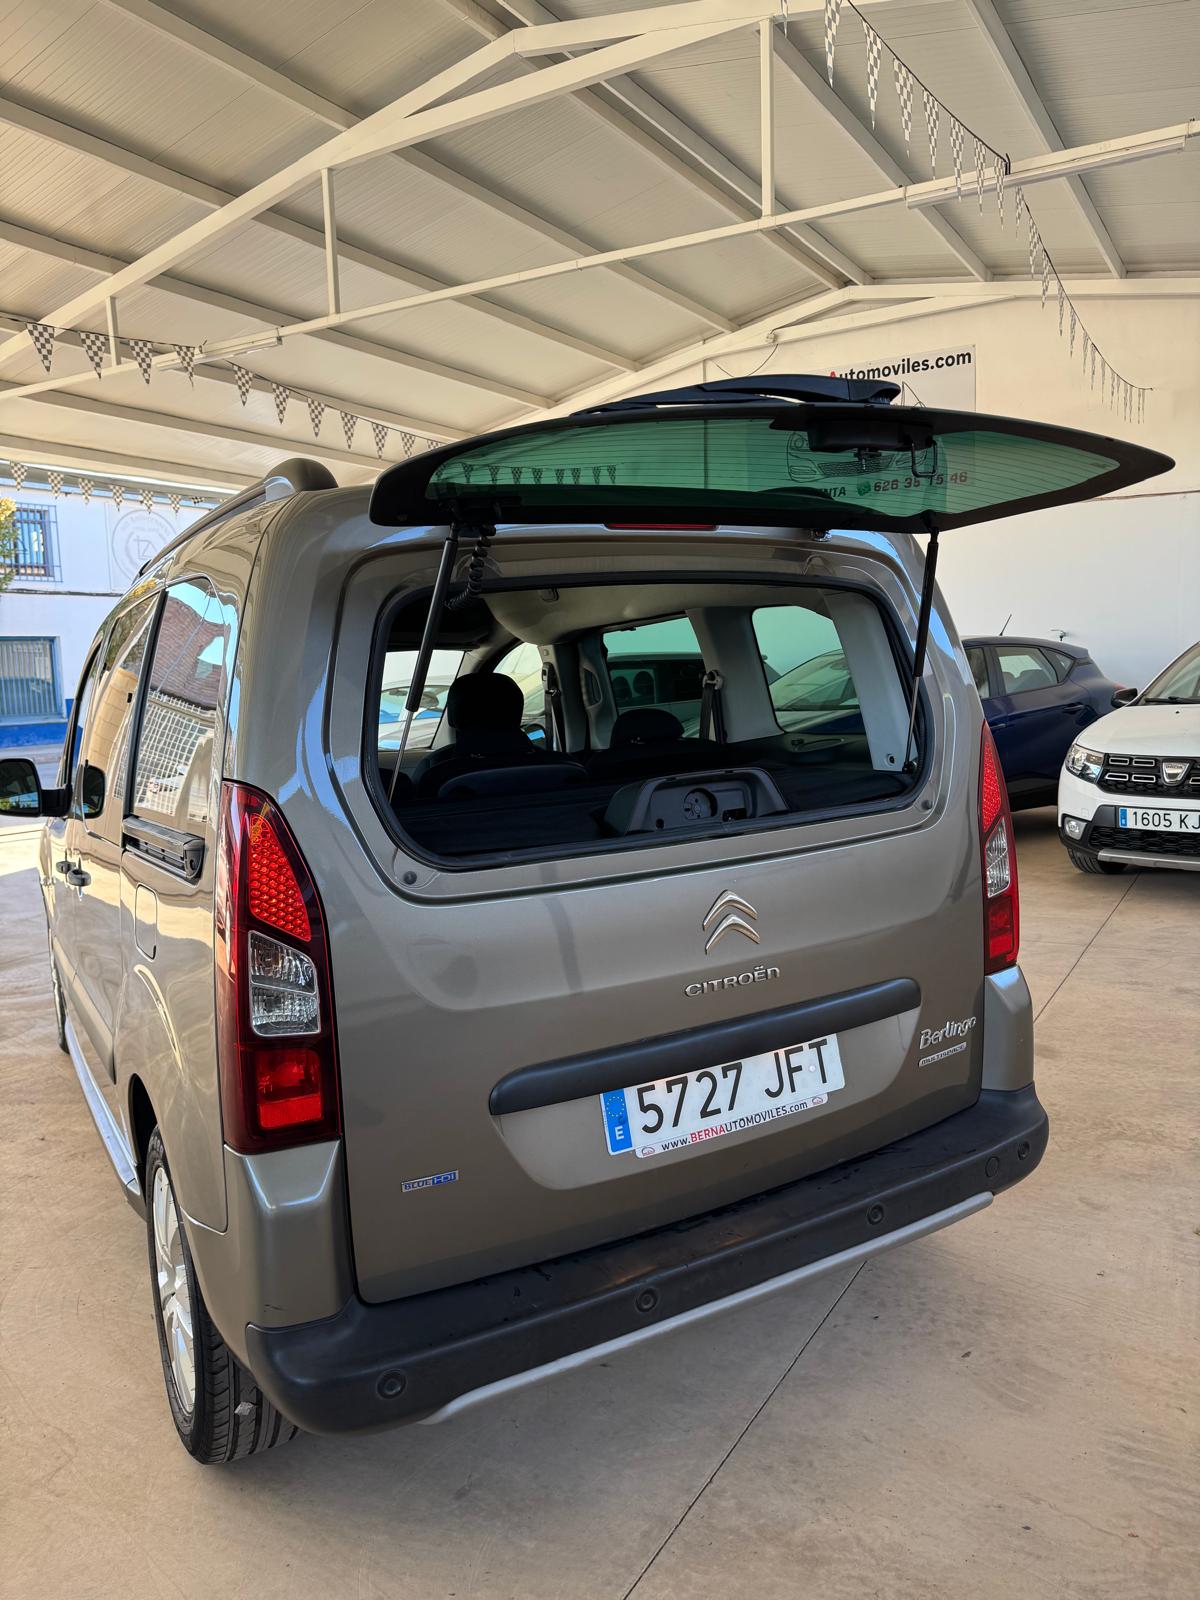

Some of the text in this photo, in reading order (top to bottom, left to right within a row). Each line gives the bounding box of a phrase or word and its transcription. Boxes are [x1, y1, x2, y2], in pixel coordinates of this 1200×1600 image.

[1132, 811, 1173, 828] 1605
[919, 1016, 977, 1050] Berlingo
[636, 1038, 828, 1134] 5727 JFT
[614, 1125, 625, 1141] E
[661, 1100, 808, 1151] www.BERNAUTOMOVILES.com
